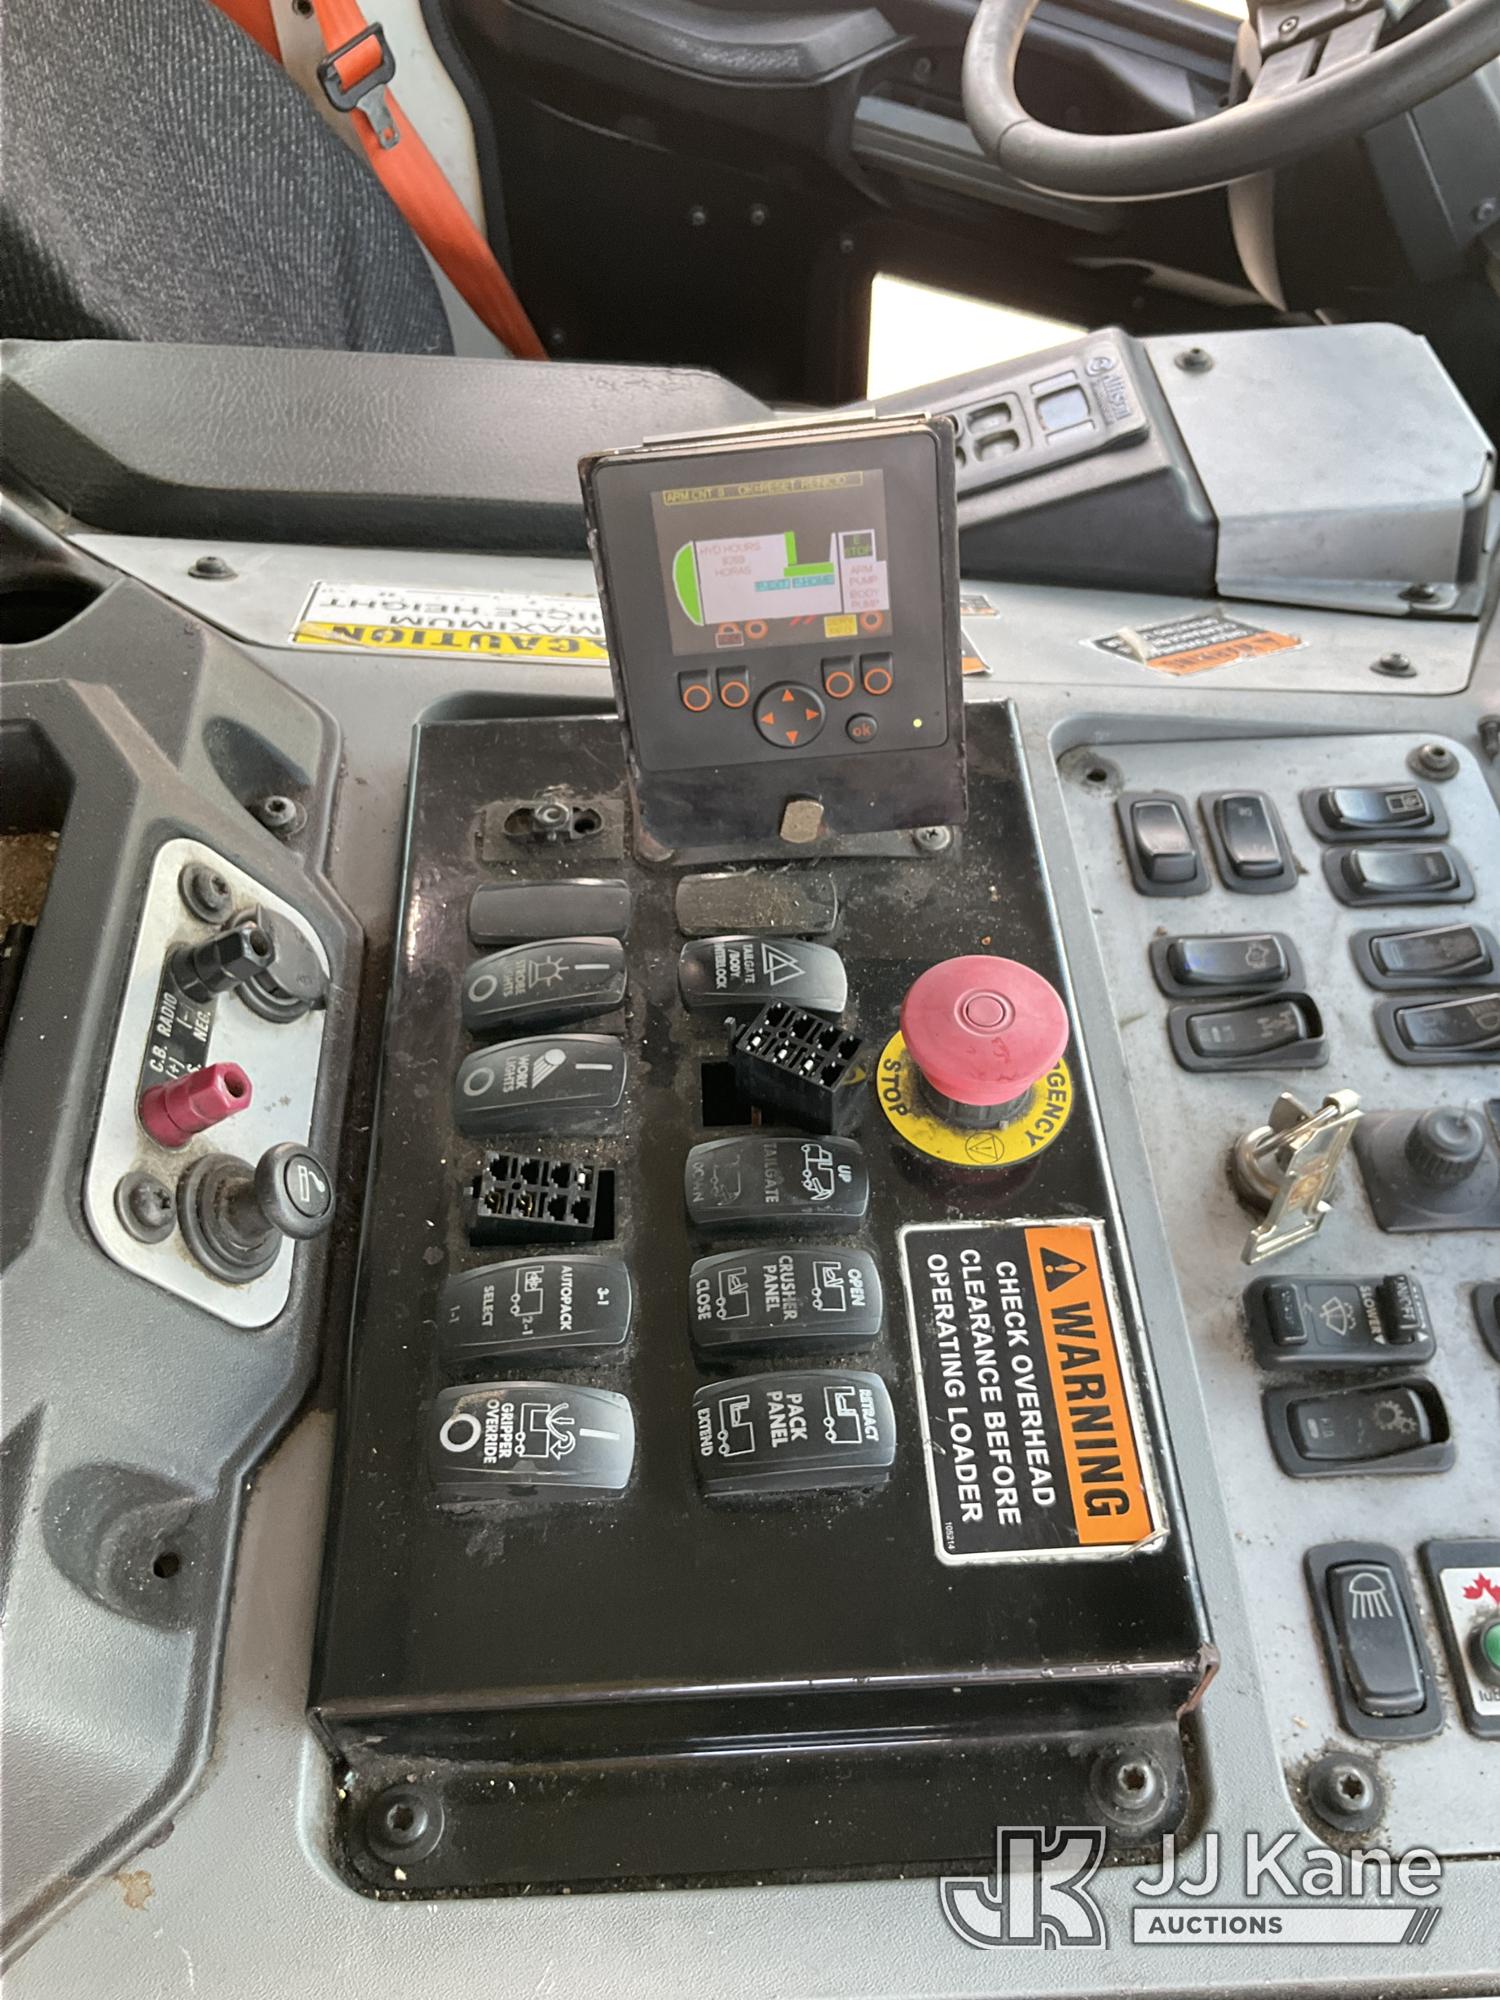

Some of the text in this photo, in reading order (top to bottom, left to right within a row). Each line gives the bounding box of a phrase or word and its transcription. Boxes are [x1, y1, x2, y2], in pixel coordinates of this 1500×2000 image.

[724, 542, 760, 553] HOURS
[715, 566, 751, 577] HORAS
[849, 575, 879, 586] PUMP
[319, 597, 479, 615] HEIGHT
[390, 614, 602, 635] MAXIMUM
[332, 626, 580, 653] CAUTION
[852, 723, 873, 737] ok
[742, 943, 756, 985] TAILGATE
[149, 992, 178, 1073] C.B. RADIO
[193, 1011, 212, 1042] NEG.
[502, 1055, 517, 1094] LIGHTS
[515, 1054, 531, 1090] WORK
[883, 1058, 908, 1117] STOP
[763, 1143, 780, 1203] TAILGATE
[837, 1164, 852, 1183] UP
[481, 1285, 495, 1327] SELECT
[560, 1265, 573, 1331] AUTOPACK
[596, 1287, 610, 1306] 3-1
[695, 1278, 712, 1320] CLOSE
[762, 1264, 781, 1312] PANEL
[778, 1255, 798, 1321] CRUSHER
[847, 1268, 866, 1307] OPEN
[1359, 1284, 1382, 1335] SLOWER
[522, 1316, 534, 1336] 2-1
[926, 1252, 984, 1523] OPERATING LOADER
[959, 1248, 1022, 1526] CLEARANCE BEFORE
[995, 1260, 1058, 1507] CHECK OVERHEAD
[483, 1399, 500, 1464] OVERRIDE
[498, 1402, 515, 1459] GRIPPER
[697, 1407, 714, 1456] EXTEND
[766, 1390, 788, 1448] PANEL
[786, 1393, 808, 1441] PACK
[858, 1388, 880, 1442] RETRACT
[1050, 1301, 1131, 1518] WARNING
